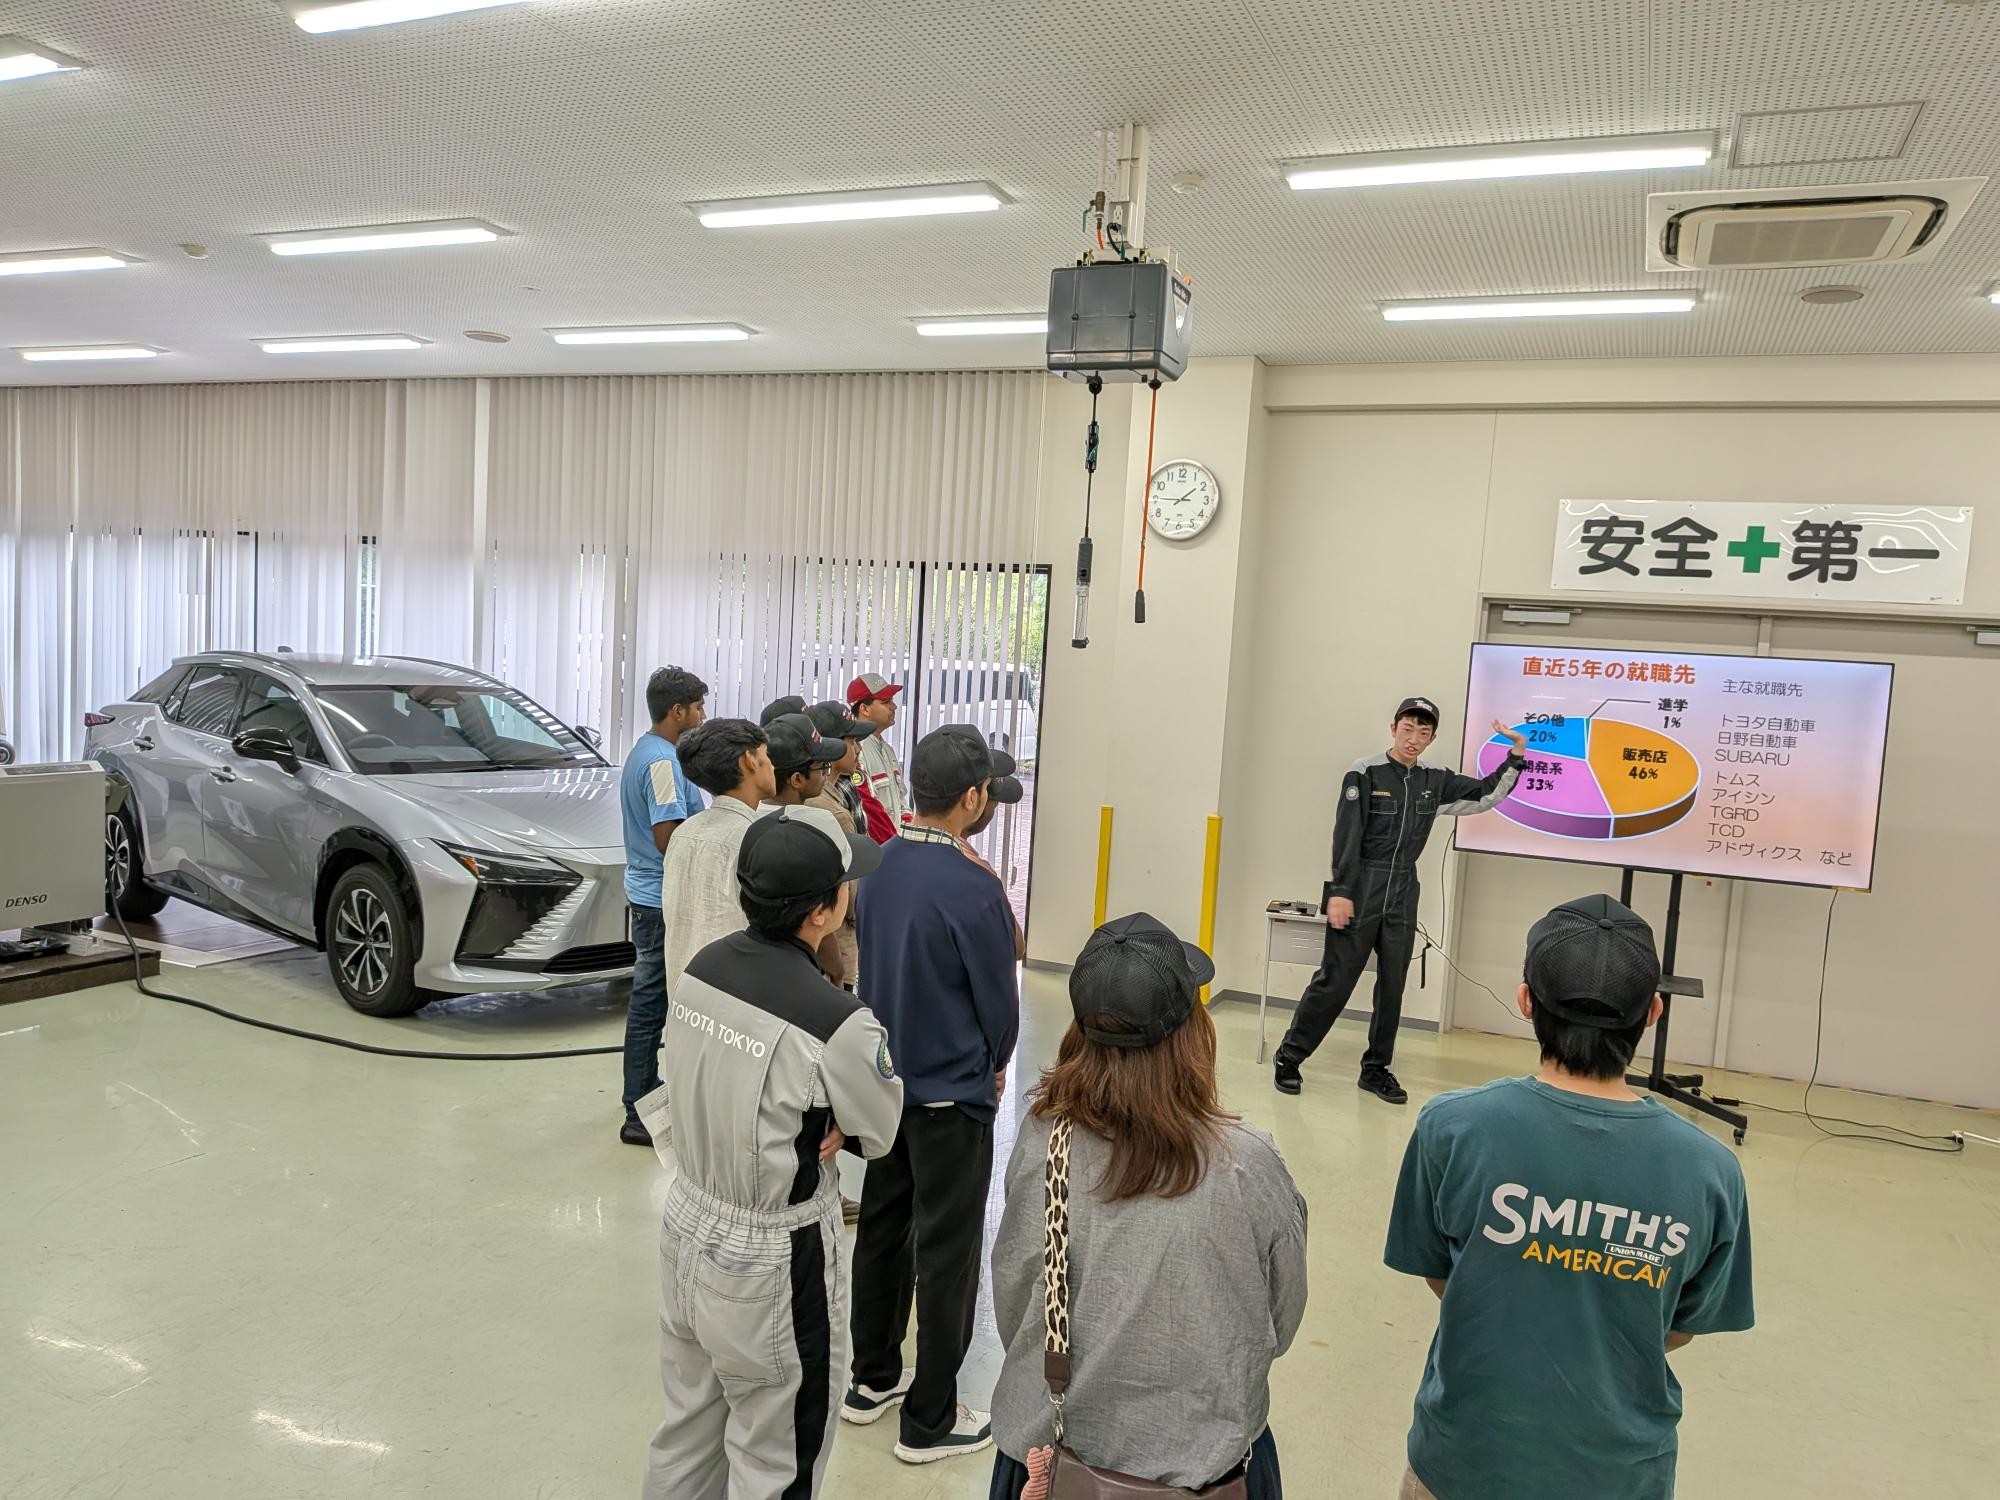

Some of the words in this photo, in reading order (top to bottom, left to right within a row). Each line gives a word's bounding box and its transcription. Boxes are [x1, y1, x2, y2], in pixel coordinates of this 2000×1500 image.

[1167, 472, 1174, 482] 11
[1178, 468, 1187, 478] 12
[1157, 481, 1166, 491] 10
[1200, 482, 1207, 491] 2
[1203, 496, 1209, 505] 3
[1155, 508, 1161, 517] 8
[1198, 509, 1204, 518] 4
[1164, 518, 1170, 527] 7
[1175, 521, 1182, 530] 6
[1188, 519, 1195, 528] 5
[1578, 516, 1718, 578] 安全
[1787, 519, 1940, 583] 第一
[1522, 656, 1696, 684] 直近5年の就職先
[1722, 679, 1803, 697] 主な就職先
[1657, 698, 1689, 712] 進学
[1524, 712, 1565, 727] その他
[1663, 716, 1682, 729] 1%
[1722, 714, 1816, 733] トヨタ自動車
[1528, 729, 1558, 743] 20%
[1718, 731, 1798, 749] 日野自動車
[1622, 747, 1668, 764] 販売店
[1714, 749, 1790, 766] SUBARU
[1522, 760, 1563, 775] 開発系
[1628, 766, 1658, 780] 46%
[1526, 778, 1554, 791] 33%
[1716, 771, 1760, 787] トムス
[1712, 788, 1775, 805] アイシン
[1710, 805, 1759, 821] TGRD
[1708, 823, 1745, 838] TCD
[1707, 840, 1802, 861] アドヴィクス
[1819, 850, 1852, 866] など
[5, 894, 47, 908] DENSO
[671, 1001, 715, 1036] TOYOTA
[718, 1023, 765, 1058] TOKYO
[1482, 1182, 1690, 1257] SMITH'S
[1610, 1246, 1635, 1257] UNION
[1636, 1250, 1661, 1264] MADE
